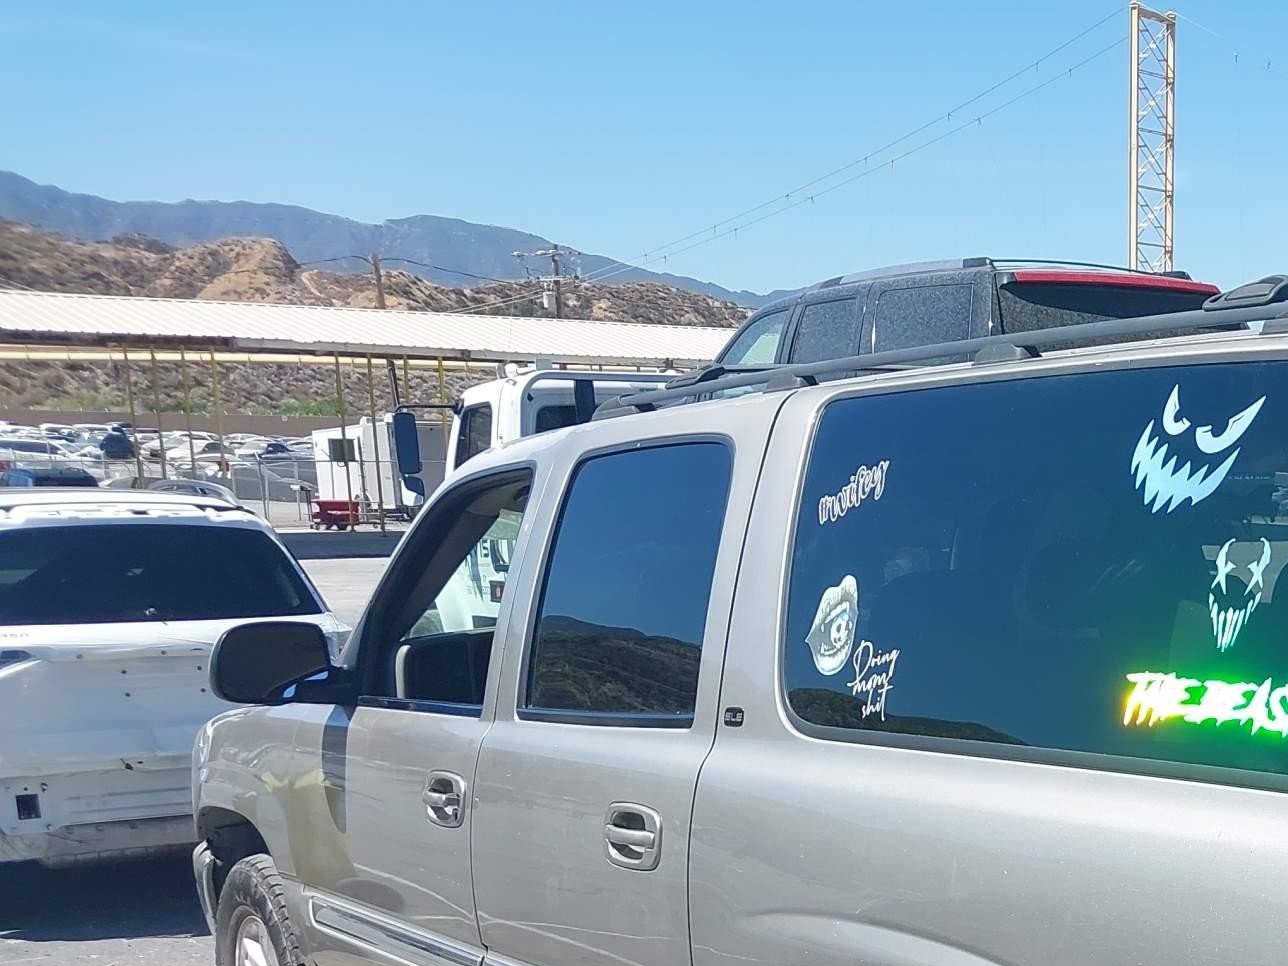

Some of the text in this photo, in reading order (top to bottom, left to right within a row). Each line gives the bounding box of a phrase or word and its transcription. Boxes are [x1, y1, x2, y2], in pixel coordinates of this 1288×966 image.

[847, 640, 900, 687] Doing
[852, 672, 889, 696] mom
[862, 687, 894, 721] shit
[1123, 671, 1202, 727] THE
